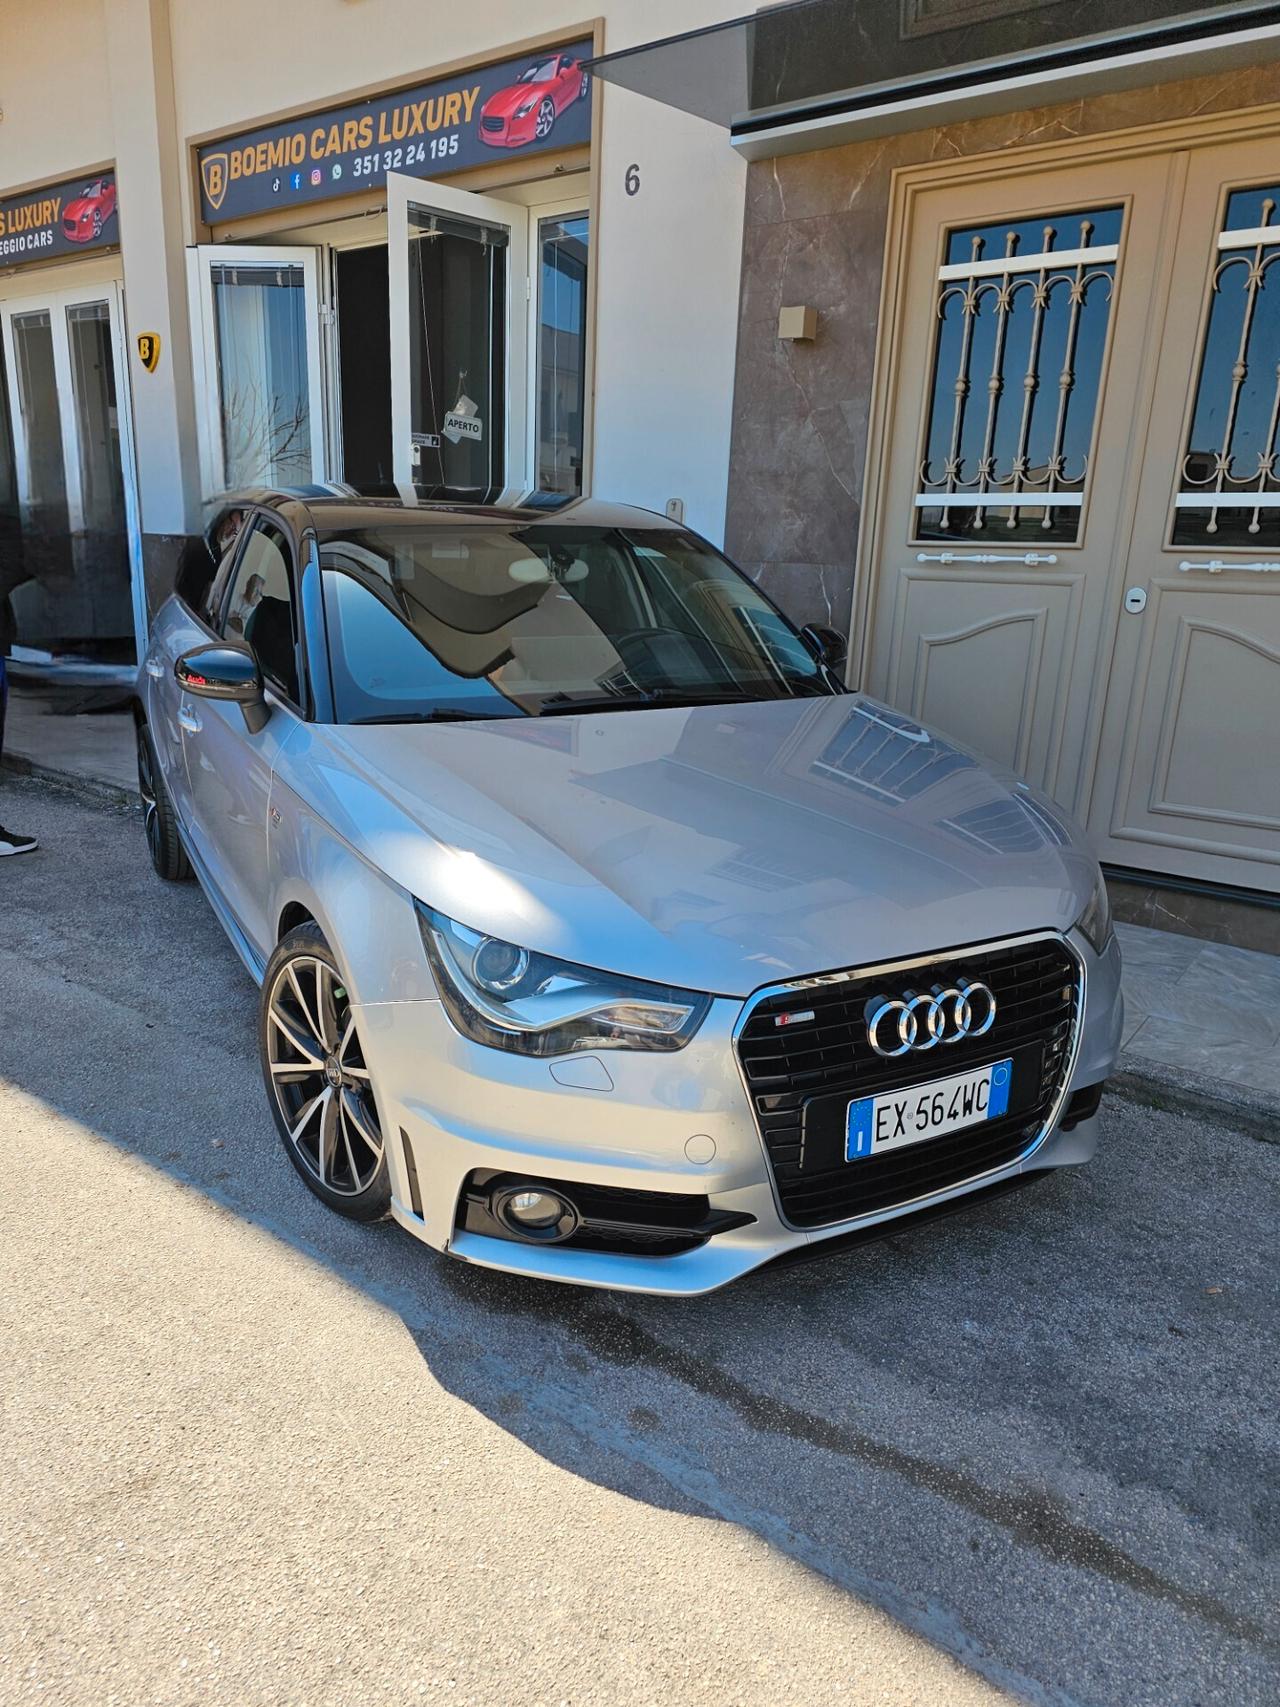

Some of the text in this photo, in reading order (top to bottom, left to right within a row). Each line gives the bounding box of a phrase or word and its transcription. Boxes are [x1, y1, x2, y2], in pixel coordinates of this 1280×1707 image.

[229, 85, 481, 180] BOEMIO CARS LUXURY
[352, 133, 459, 177] 351 32 24 195
[625, 163, 640, 197] 6
[8, 197, 61, 234] LUXURY
[27, 229, 53, 250] CARS
[140, 338, 150, 360] B
[447, 418, 479, 433] APERTO
[875, 1078, 990, 1142] EX 564WC
